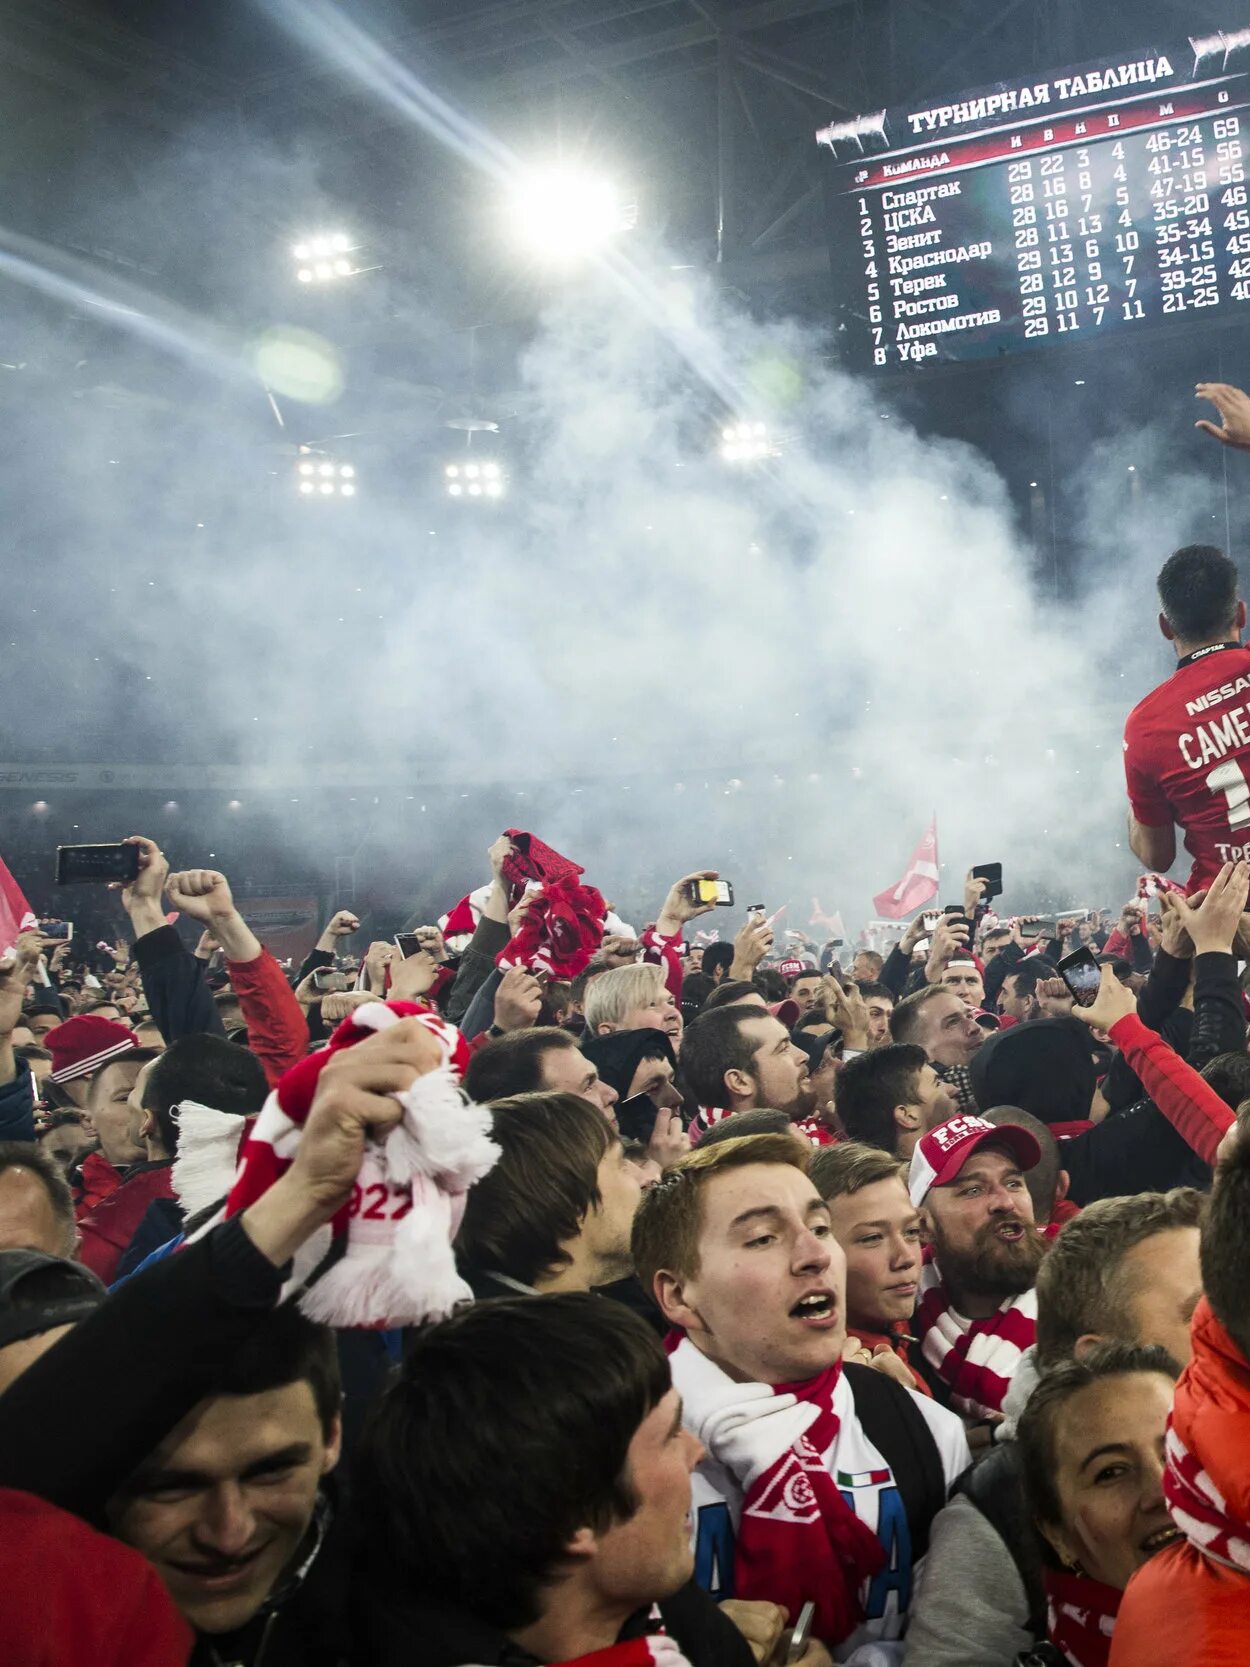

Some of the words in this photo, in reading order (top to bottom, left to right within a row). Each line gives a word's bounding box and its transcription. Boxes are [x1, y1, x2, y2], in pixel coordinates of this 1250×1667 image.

[908, 84, 1051, 133] ТУРНИРНАЯ
[1054, 56, 1174, 99] ТАБЛИЦА
[1011, 136, 1022, 148] И
[1044, 129, 1053, 141] В
[1075, 122, 1086, 134] Н
[1108, 114, 1120, 126] П
[1159, 103, 1174, 116] М
[858, 198, 869, 215] 1
[882, 181, 962, 210] Спартак
[1008, 162, 1032, 182] 29
[1041, 155, 1064, 175] 22
[1078, 150, 1089, 167] 3
[1112, 142, 1125, 159] 4
[1146, 125, 1202, 152] 46-24
[1214, 118, 1239, 139] 69
[861, 218, 873, 236] 2
[884, 205, 936, 232] ЦСКА
[1011, 184, 1034, 204] 28
[1043, 177, 1066, 197] 16
[1079, 172, 1091, 190] 8
[1114, 165, 1127, 182] 4
[1148, 148, 1204, 174] 41-15
[1217, 140, 1242, 161] 56
[863, 240, 875, 258] 3
[886, 230, 942, 253] Зенит
[1013, 206, 1036, 226] 28
[1046, 200, 1068, 220] 16
[1081, 194, 1092, 212] 7
[1117, 187, 1129, 205] 5
[1151, 172, 1207, 197] 47-19
[1219, 164, 1244, 185] 55
[865, 261, 878, 278] 4
[888, 241, 992, 275] Краснодар
[1015, 228, 1038, 248] 28
[1048, 222, 1069, 242] 11
[1079, 215, 1102, 235] 13
[1118, 209, 1132, 227] 4
[1153, 194, 1209, 221] 35-20
[1221, 186, 1247, 207] 46
[868, 283, 879, 301] 5
[890, 274, 947, 296] Терек
[1018, 250, 1041, 271] 29
[1050, 244, 1073, 264] 13
[1086, 239, 1099, 258] 6
[1116, 232, 1139, 252] 10
[1155, 217, 1212, 244] 35-34
[1224, 210, 1250, 231] 45
[870, 305, 882, 323] 6
[893, 294, 959, 318] Ростов
[1020, 274, 1043, 294] 28
[1052, 267, 1076, 288] 12
[1088, 262, 1101, 280] 9
[1123, 256, 1134, 274] 7
[1158, 240, 1214, 268] 34-15
[872, 327, 883, 345] 7
[896, 309, 1001, 341] Локомотив
[1022, 296, 1046, 316] 29
[1054, 290, 1078, 310] 10
[1086, 284, 1109, 305] 12
[1125, 279, 1137, 297] 7
[1160, 264, 1217, 291] 39-25
[874, 347, 887, 365] 8
[897, 341, 938, 362] Уфа
[1024, 317, 1048, 338] 29
[1057, 312, 1079, 332] 11
[1093, 306, 1105, 325] 7
[1122, 300, 1145, 320] 11
[1162, 286, 1219, 313] 21-25
